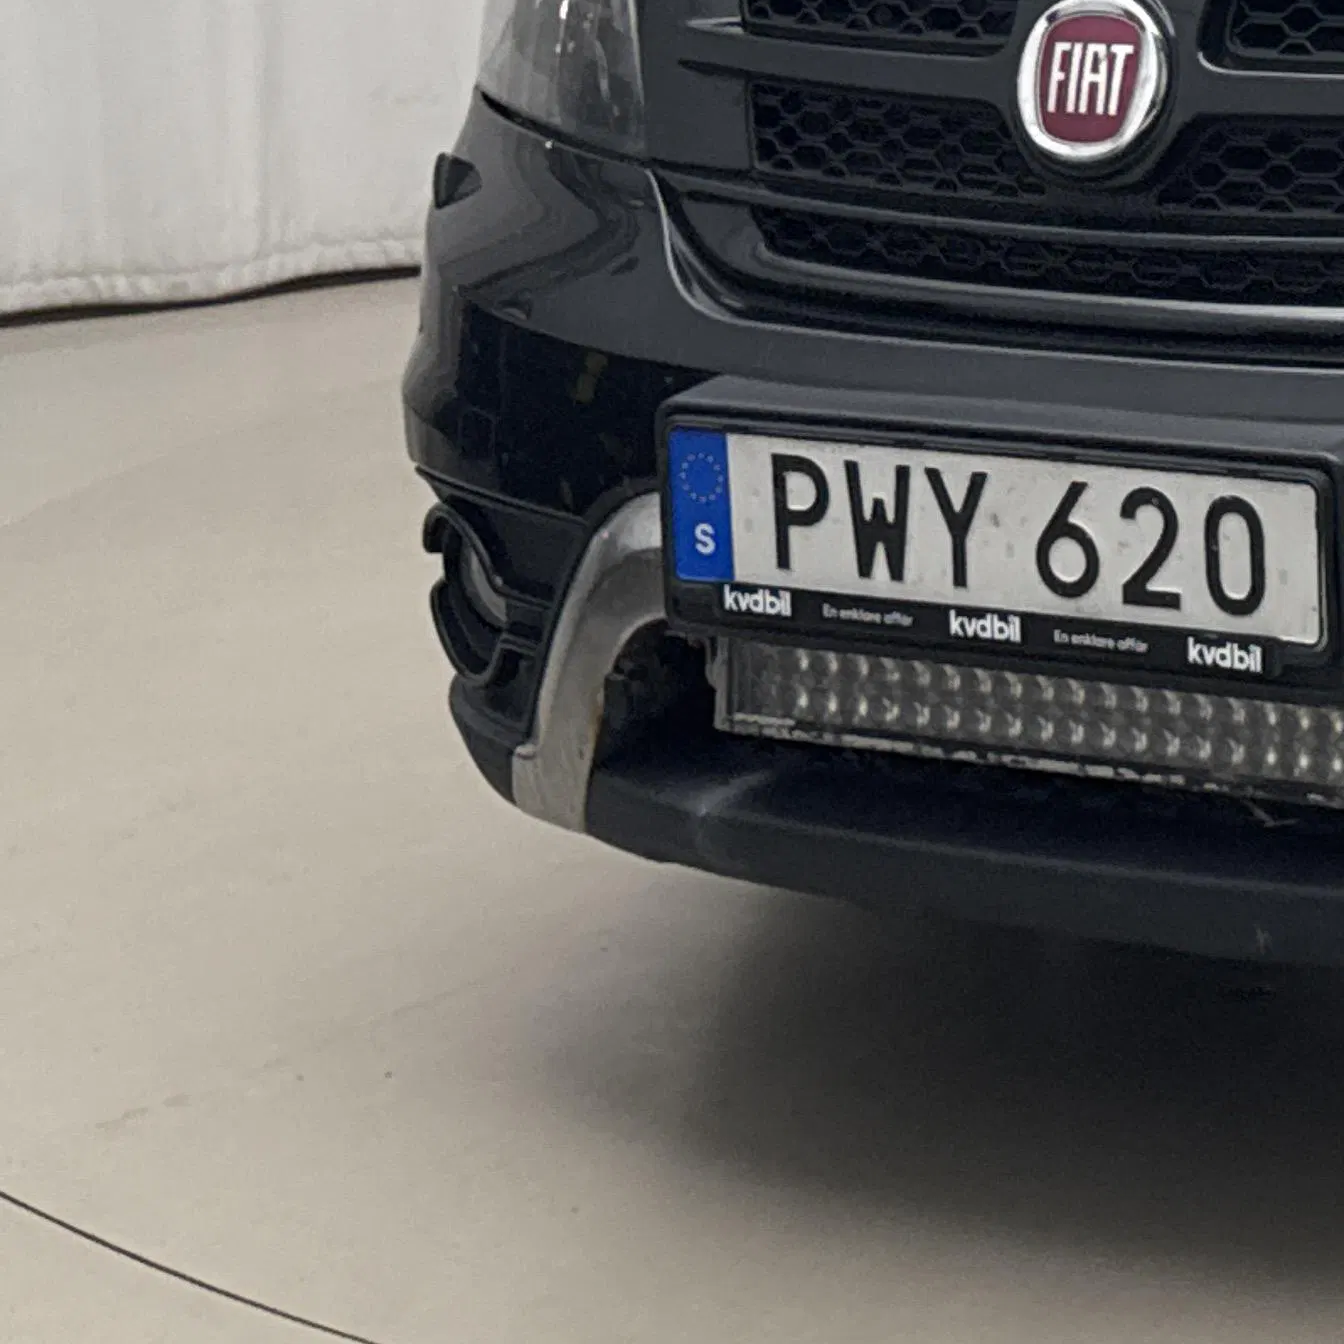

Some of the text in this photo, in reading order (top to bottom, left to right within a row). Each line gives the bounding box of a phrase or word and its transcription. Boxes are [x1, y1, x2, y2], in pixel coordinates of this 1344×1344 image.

[1046, 41, 1135, 116] FIAT
[694, 522, 716, 556] S
[770, 452, 1267, 618] PWY 620
[723, 583, 792, 617] kvdbil
[949, 609, 1022, 644] kvdbil
[1187, 635, 1263, 673] kvdbil
